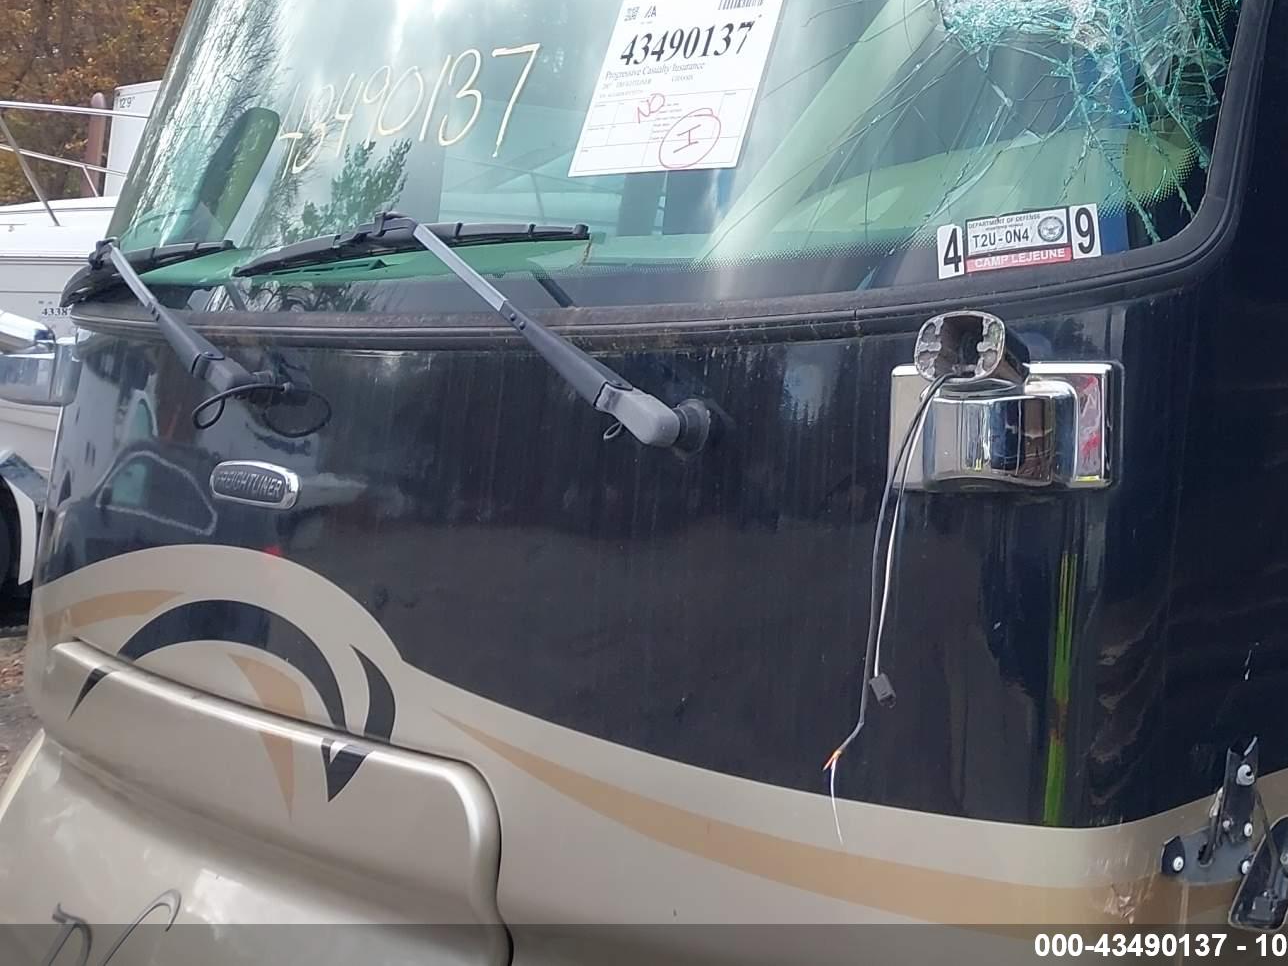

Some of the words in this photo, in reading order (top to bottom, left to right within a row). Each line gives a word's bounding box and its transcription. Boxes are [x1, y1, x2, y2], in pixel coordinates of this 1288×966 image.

[619, 21, 755, 66] 43490137
[277, 42, 541, 181] 43490137
[968, 218, 1005, 229] DEPARTMENT
[1015, 213, 1041, 223] DEFENSE
[1074, 207, 1096, 254] 9
[943, 228, 962, 273] 4
[975, 255, 1009, 268] CAMP
[1011, 248, 1065, 264] LEJEUNE
[215, 470, 283, 499] FREIGHTLINER
